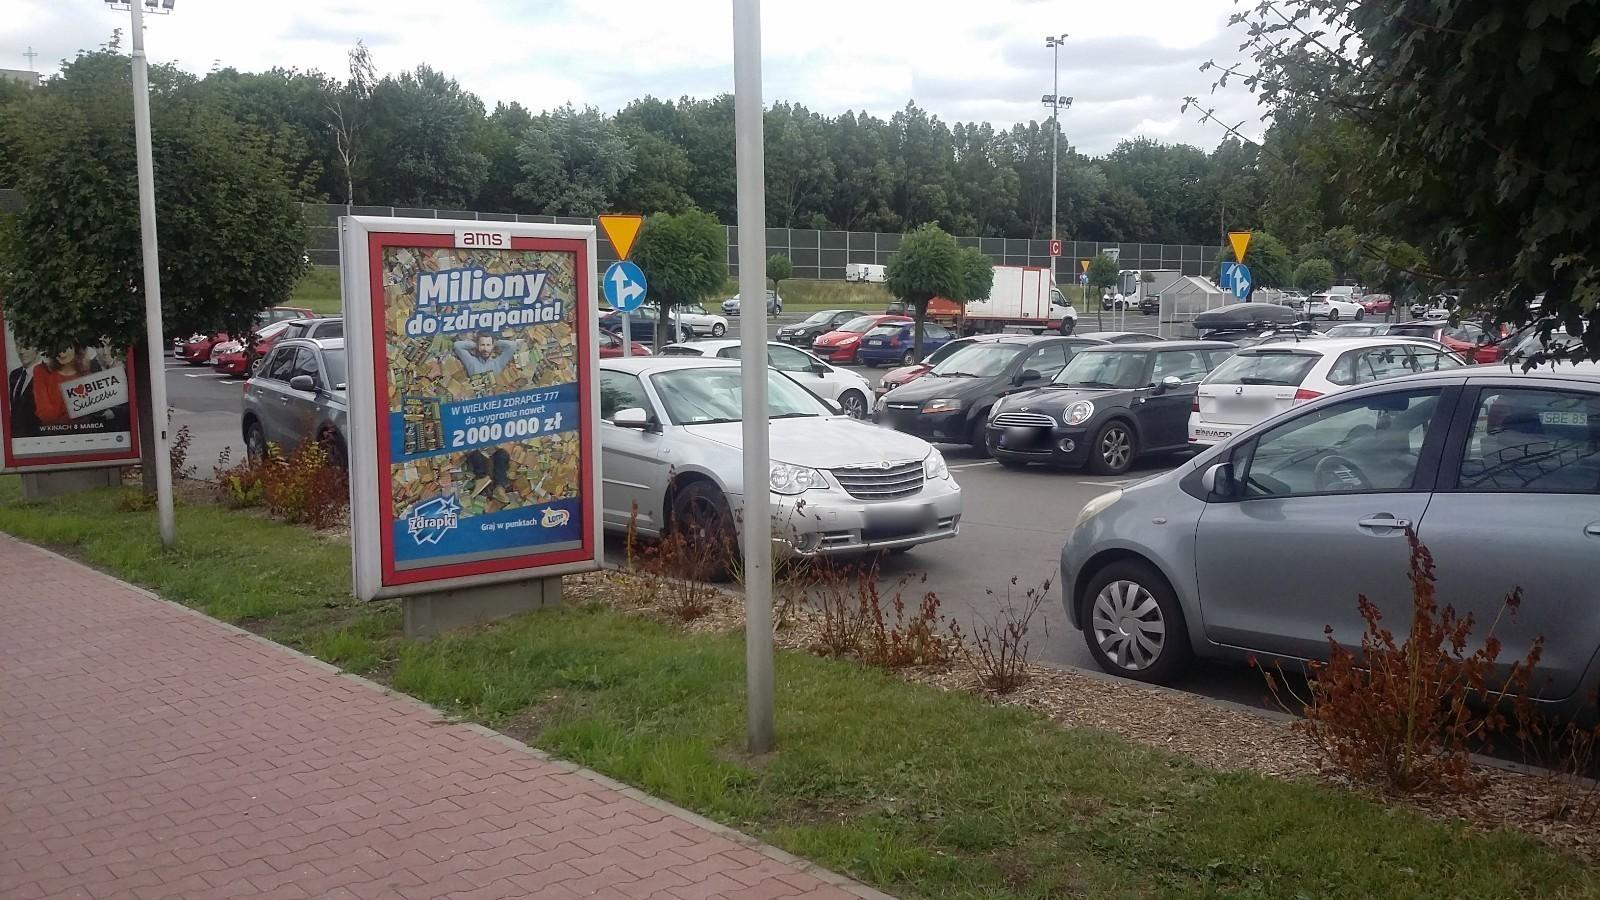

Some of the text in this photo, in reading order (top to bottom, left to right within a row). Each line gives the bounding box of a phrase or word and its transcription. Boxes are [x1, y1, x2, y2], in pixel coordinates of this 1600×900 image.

[463, 232, 503, 246] ams
[418, 270, 546, 305] Miliony
[408, 302, 562, 335] do zdrapania!
[451, 391, 559, 416] W WIELKIEJ ZDRAPCE 777
[465, 405, 546, 426] do wygrania nawet
[544, 411, 563, 432] zł
[1544, 412, 1569, 424] SBE
[481, 522, 495, 531] Graj
[505, 517, 537, 530] punktach
